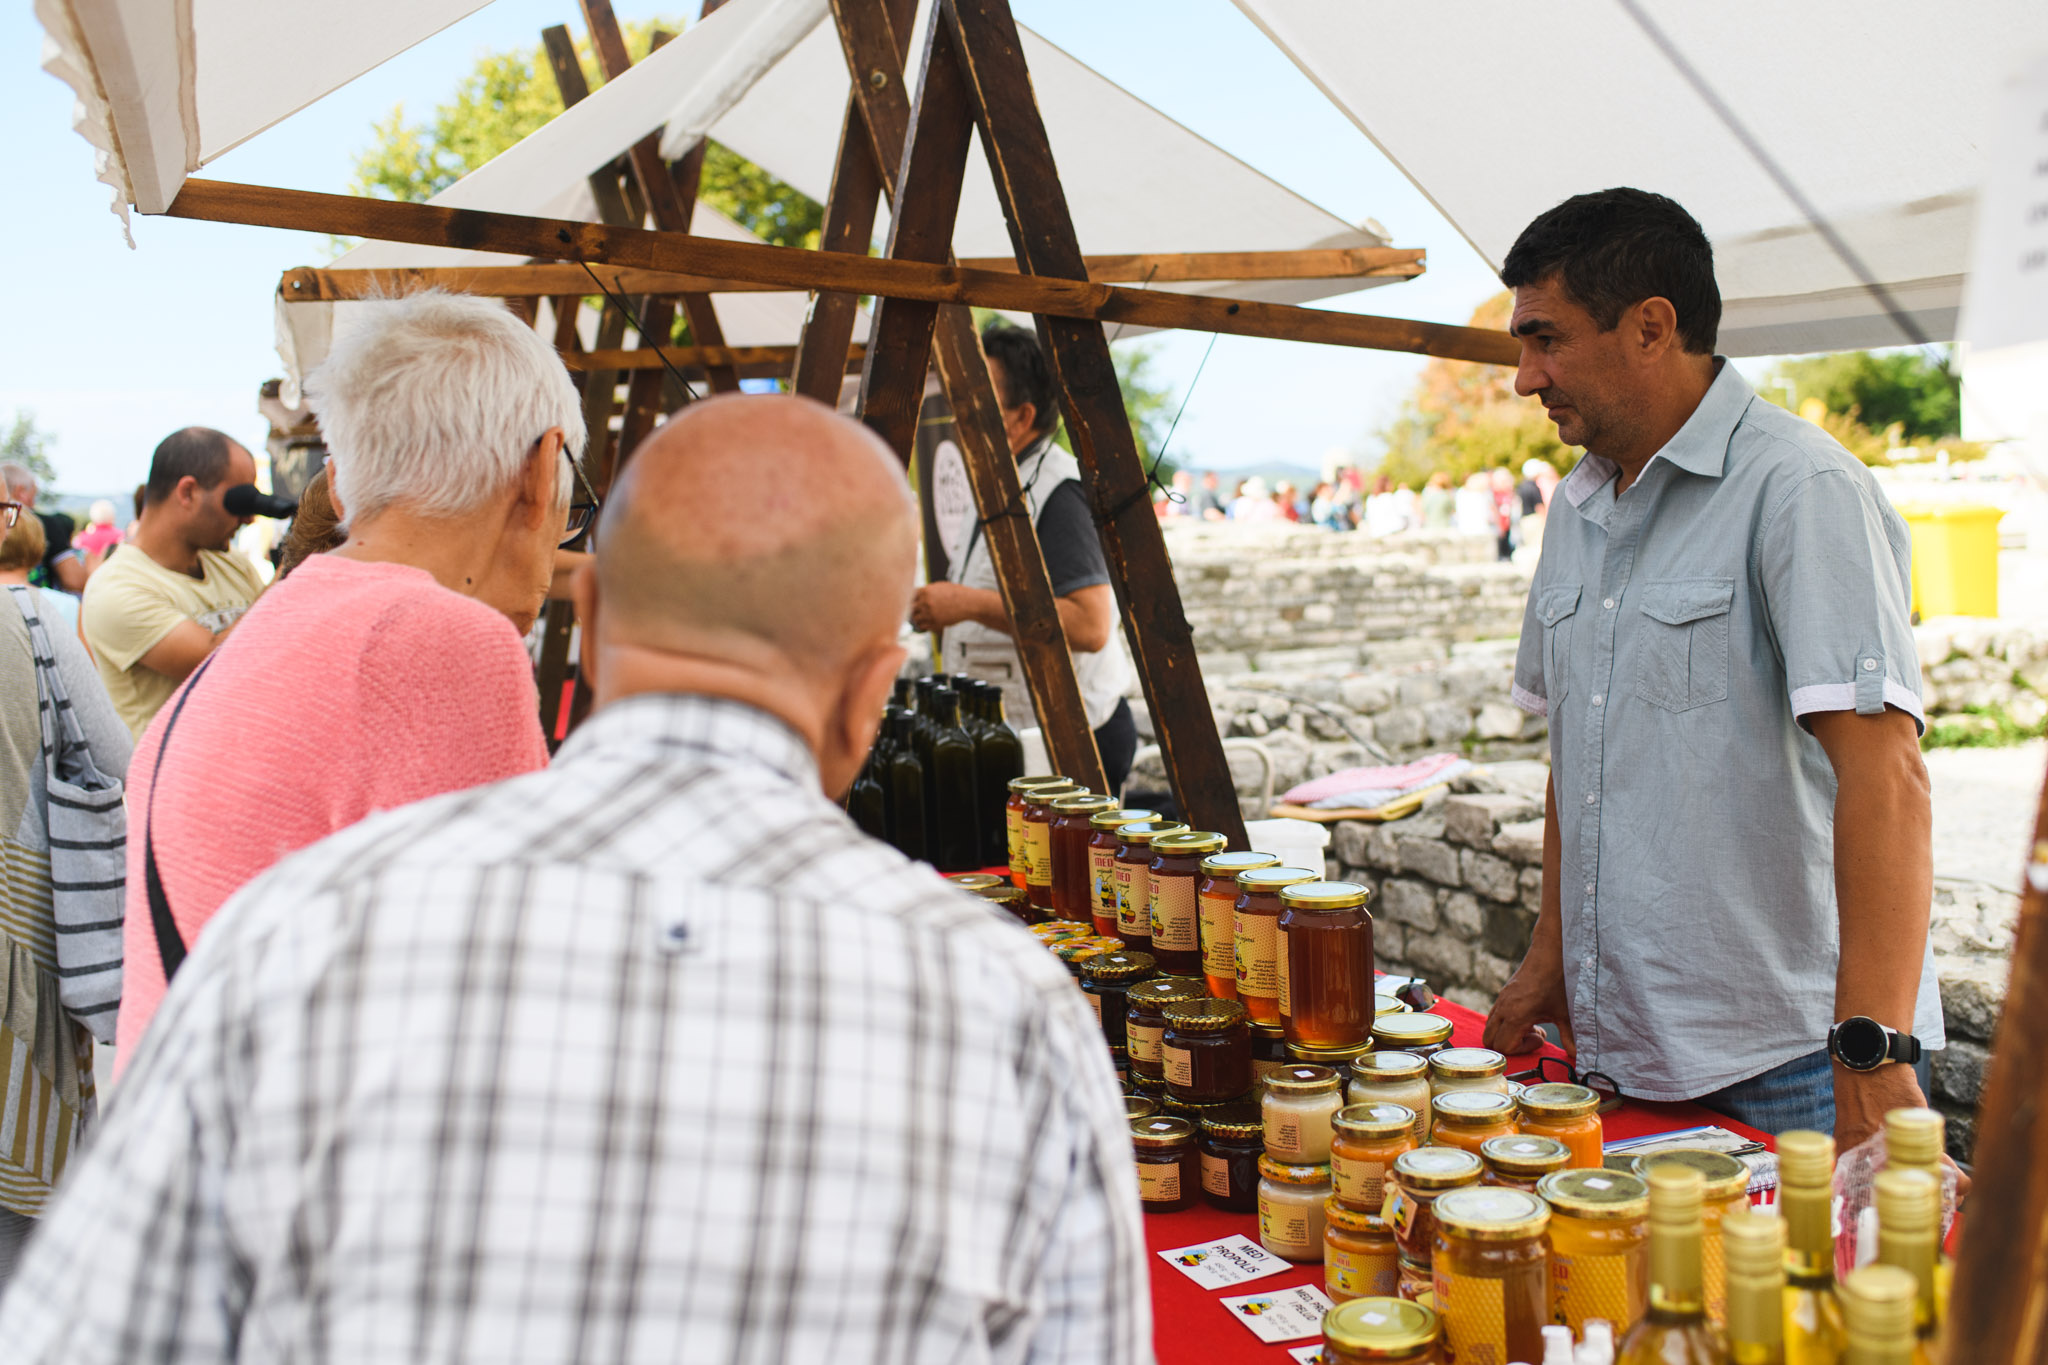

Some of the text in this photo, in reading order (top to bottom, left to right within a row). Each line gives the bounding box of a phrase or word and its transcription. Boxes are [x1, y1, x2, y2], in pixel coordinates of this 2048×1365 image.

[1095, 857, 1114, 868] MED
[1116, 870, 1131, 883] MED
[1211, 1244, 1260, 1274] PROPOLIS
[1238, 1244, 1264, 1259] MED
[1551, 1262, 1569, 1280] ED
[1291, 1303, 1318, 1321] PELUD
